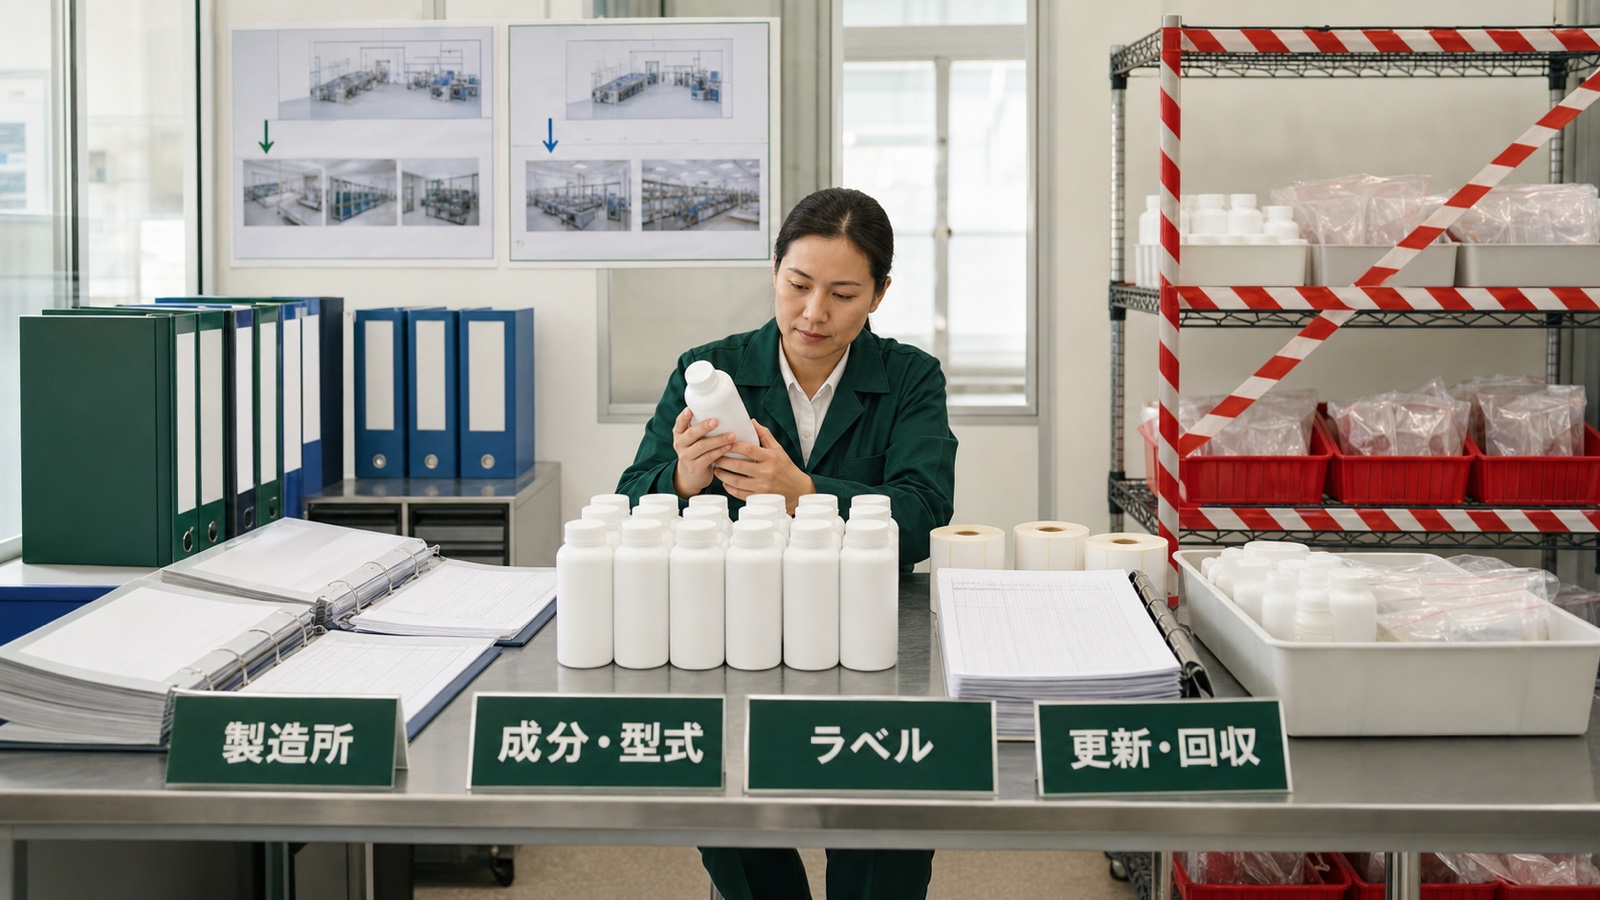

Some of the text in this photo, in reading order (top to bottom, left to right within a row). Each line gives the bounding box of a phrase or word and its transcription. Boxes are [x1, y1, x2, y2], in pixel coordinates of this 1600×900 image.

[222, 721, 354, 765] 製造所
[497, 719, 704, 763] 成分・型式
[810, 726, 934, 765] ラベル
[1069, 725, 1261, 769] 更新・回収
